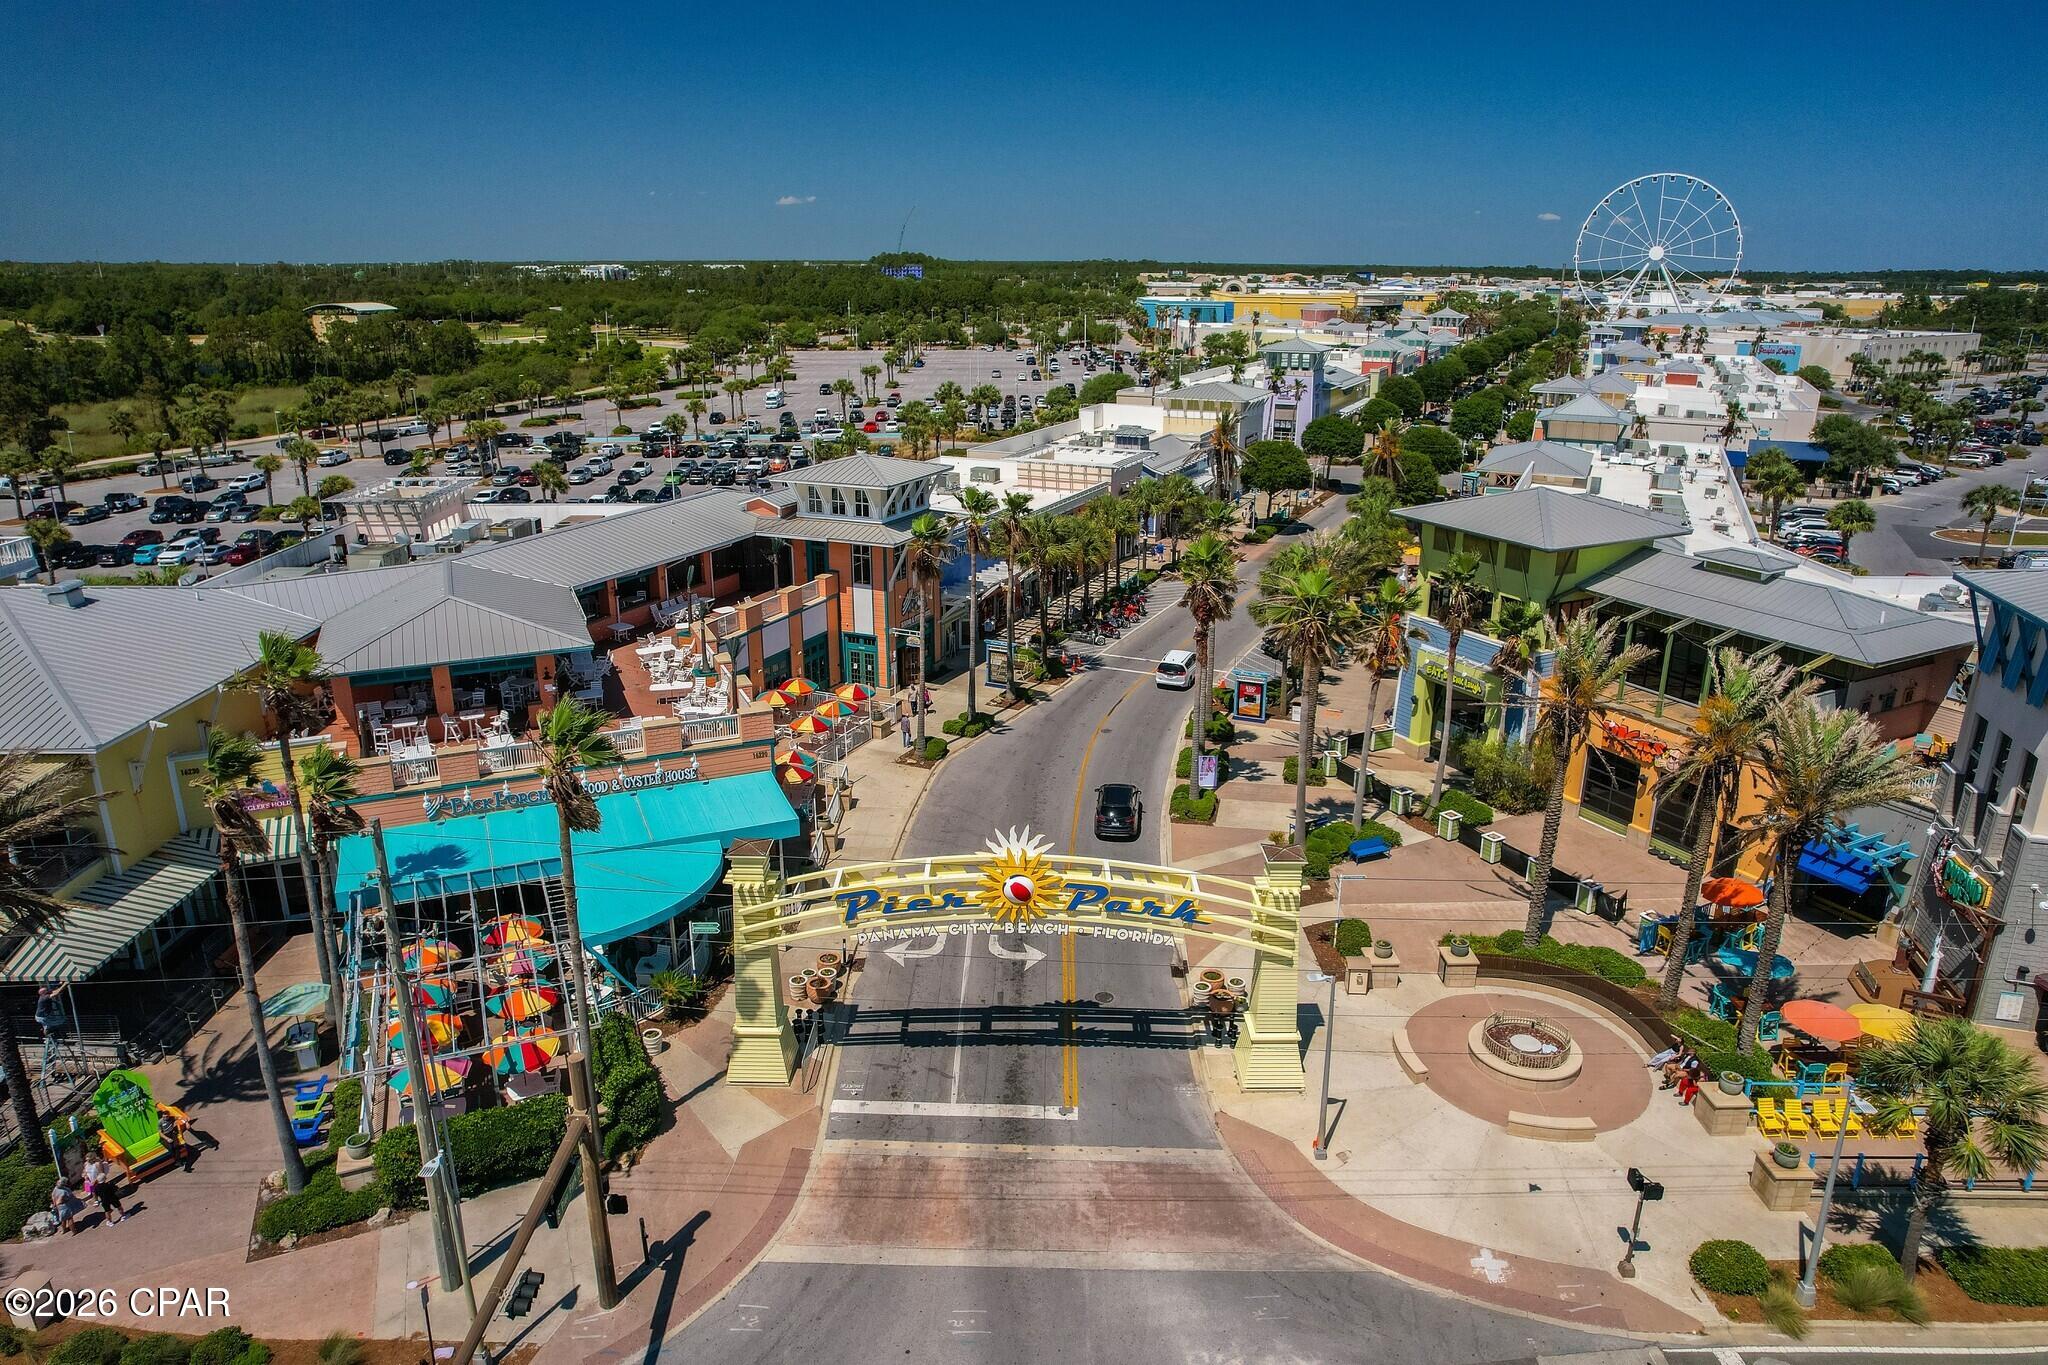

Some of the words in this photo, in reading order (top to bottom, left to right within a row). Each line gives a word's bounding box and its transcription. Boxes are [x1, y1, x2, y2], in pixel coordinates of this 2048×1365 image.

[1426, 665, 1443, 679] EAT
[623, 772, 663, 789] OYSTER
[664, 767, 697, 783] HOUSE
[835, 888, 983, 925] Pier
[1062, 882, 1214, 925] Park
[857, 924, 941, 946] PANAMA
[948, 922, 995, 936] CITY
[1004, 922, 1070, 936] BEACH
[1092, 926, 1176, 948] FLORIDA
